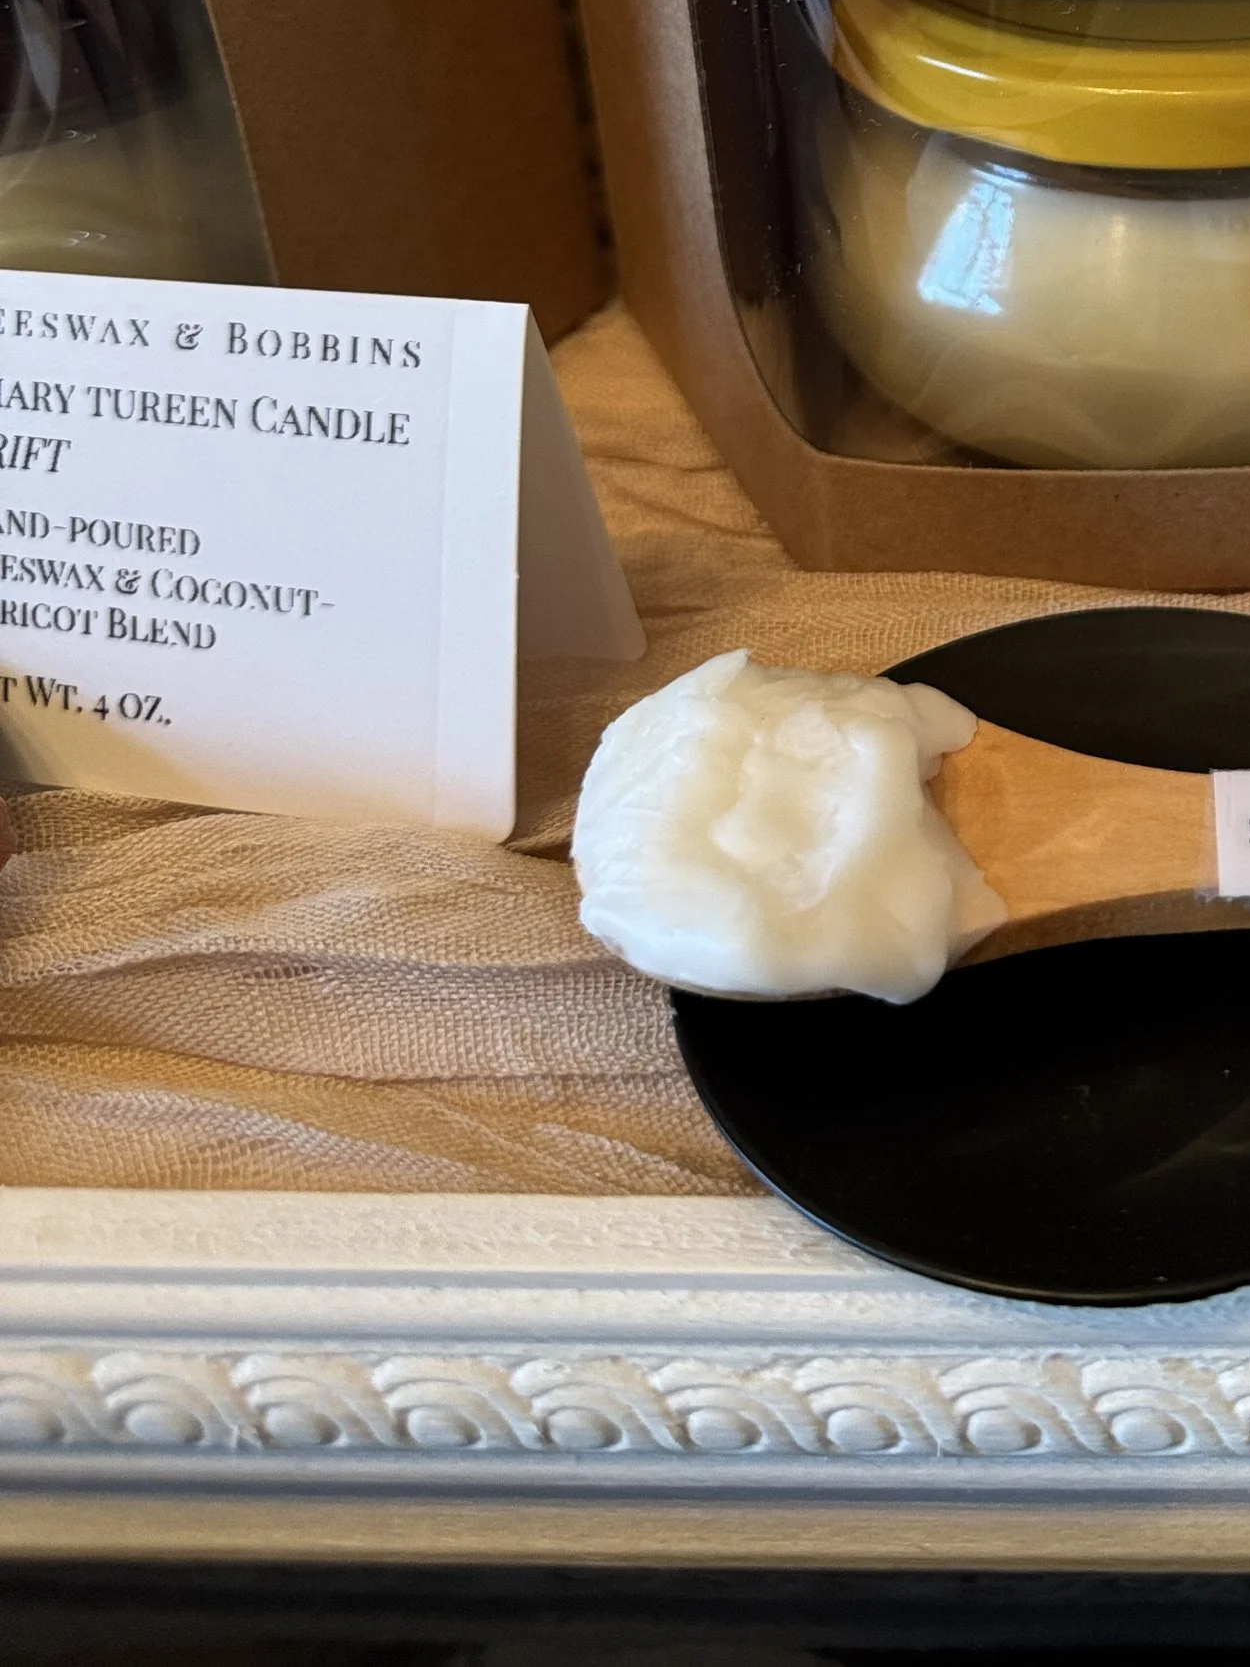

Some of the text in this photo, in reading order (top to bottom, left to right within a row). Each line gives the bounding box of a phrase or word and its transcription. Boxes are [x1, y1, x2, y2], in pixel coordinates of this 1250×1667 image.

[0, 307, 423, 370] ESWAX & BOBBINS
[84, 385, 240, 430] TUREEN
[247, 395, 411, 447] CANDLE
[0, 508, 202, 559] ND-POURED
[111, 567, 143, 598] &
[105, 606, 218, 651] BLEND
[23, 674, 84, 714] WT.
[91, 694, 110, 721] 4
[116, 692, 173, 727] OZ.
